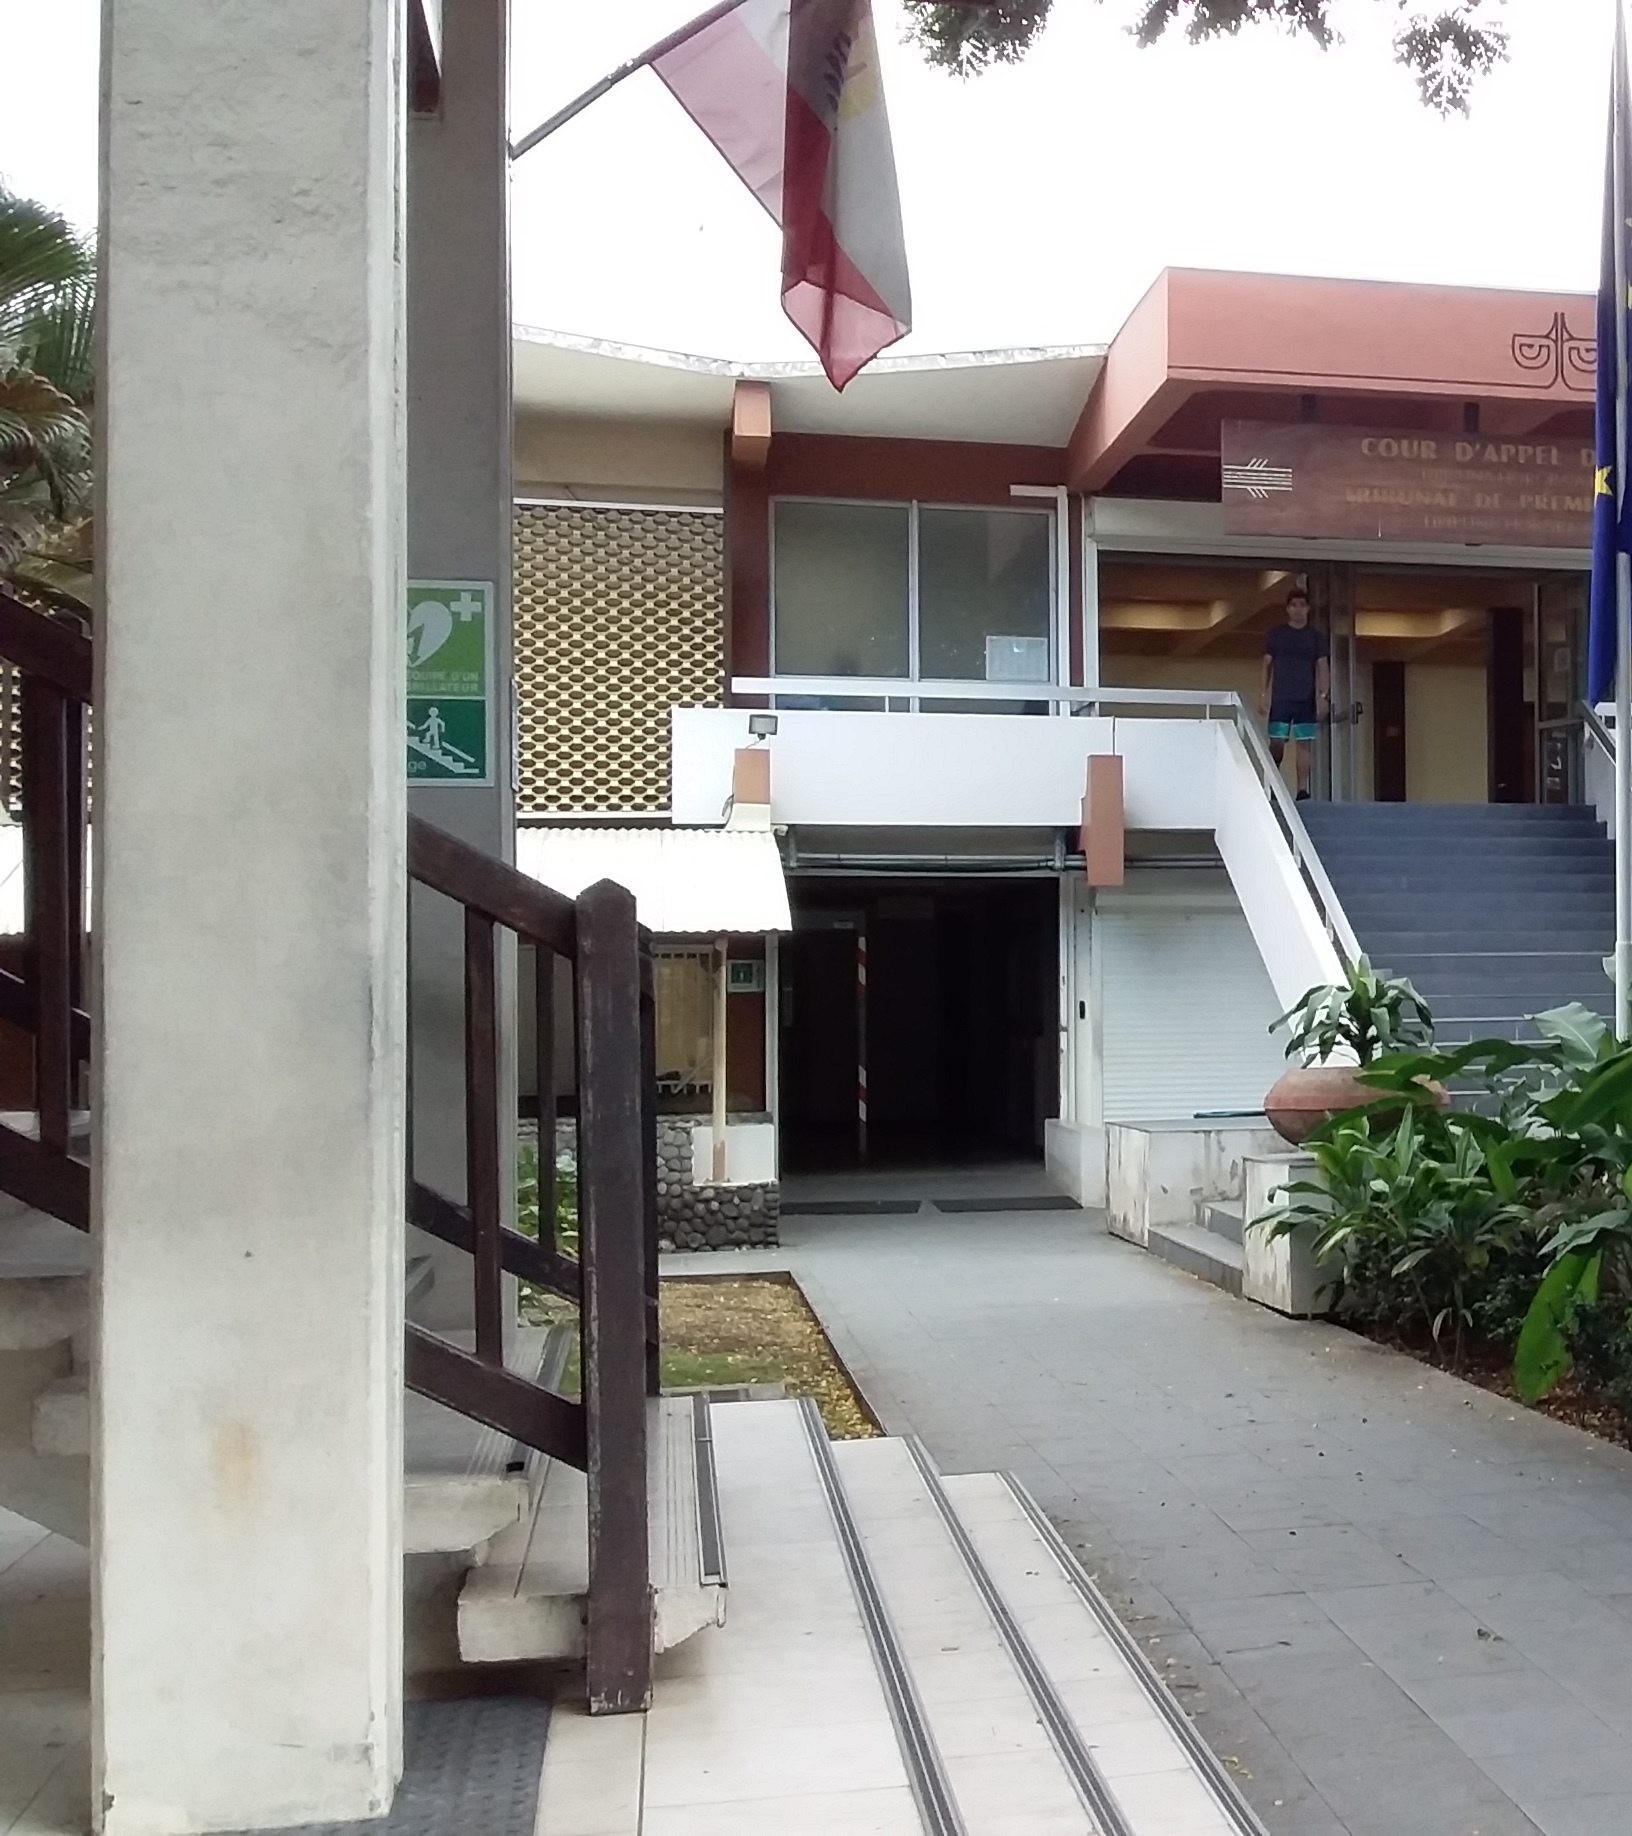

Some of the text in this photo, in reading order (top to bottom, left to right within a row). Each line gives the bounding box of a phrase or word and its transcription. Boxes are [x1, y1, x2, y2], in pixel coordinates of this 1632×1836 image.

[1360, 437, 1438, 460] COUR
[1454, 441, 1562, 467] D'APPEL
[1580, 447, 1597, 468] D
[1518, 493, 1594, 513] PREMI
